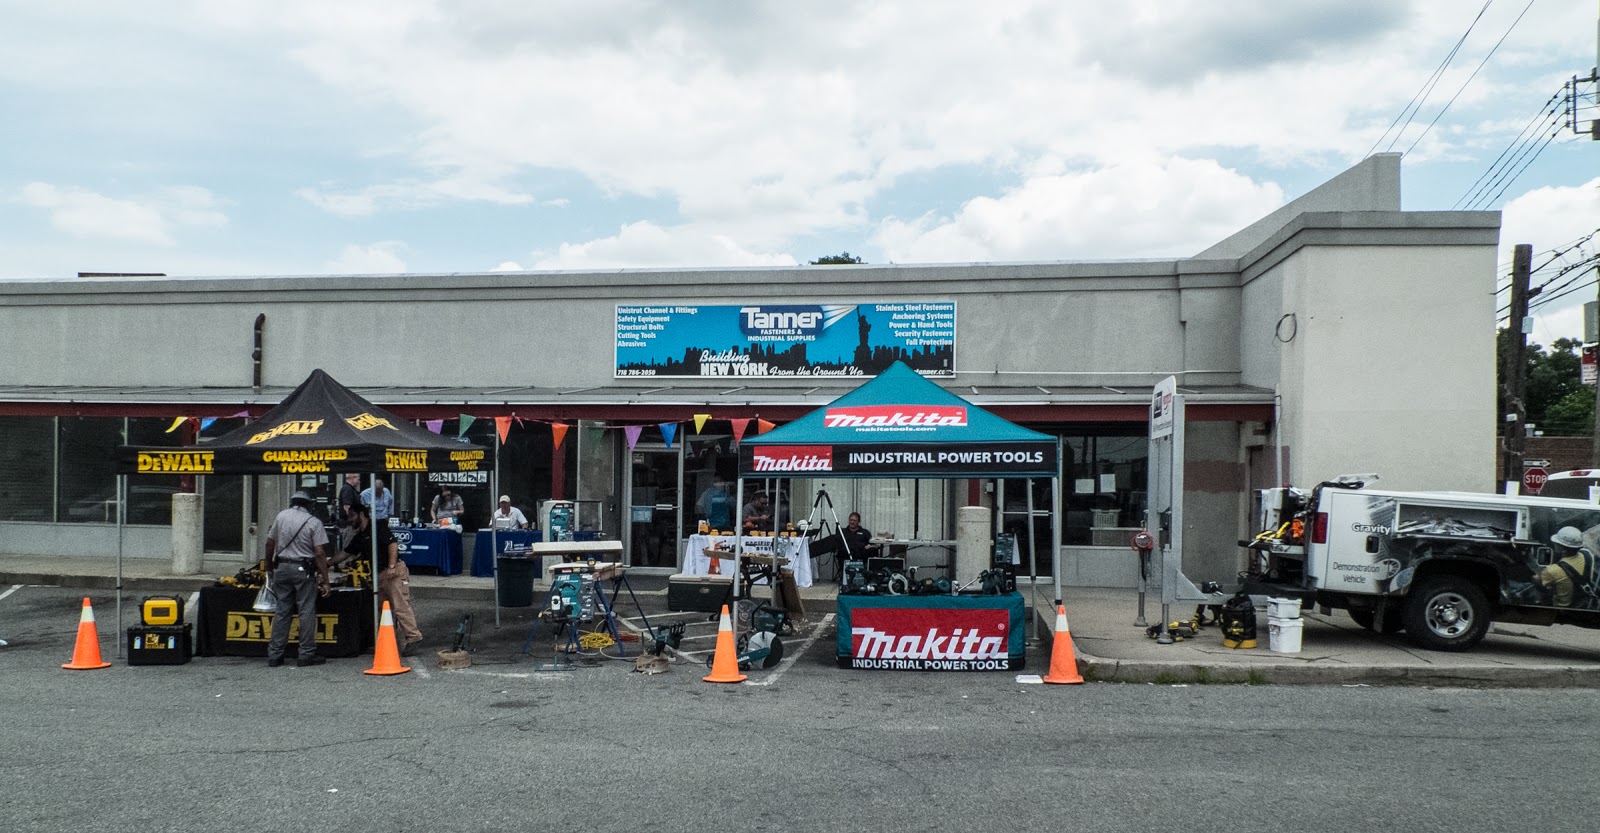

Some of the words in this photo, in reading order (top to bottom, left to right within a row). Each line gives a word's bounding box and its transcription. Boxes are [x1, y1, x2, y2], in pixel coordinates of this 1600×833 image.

[740, 307, 822, 328] Tanner
[618, 332, 640, 340] Cutting
[699, 349, 750, 364] Building
[700, 362, 730, 376] NEW
[732, 362, 768, 376] YORK
[770, 366, 794, 376] From
[797, 366, 811, 376] the
[812, 366, 846, 376] Ground
[848, 366, 864, 376] Up
[263, 449, 348, 462] GUARANTEED
[450, 450, 484, 461] GUARANTEED
[849, 452, 936, 464] INDUSTRIAL
[938, 452, 990, 464] POWER
[994, 452, 1043, 463] TOOLS
[1526, 474, 1546, 484] STOP
[1352, 522, 1390, 535] Gravity
[1333, 562, 1380, 572] Demonstration
[1344, 575, 1366, 583] Vehicle
[852, 659, 924, 670] INDUSTRIAL
[924, 660, 970, 670] POWER
[970, 660, 1008, 670] TOOLS
